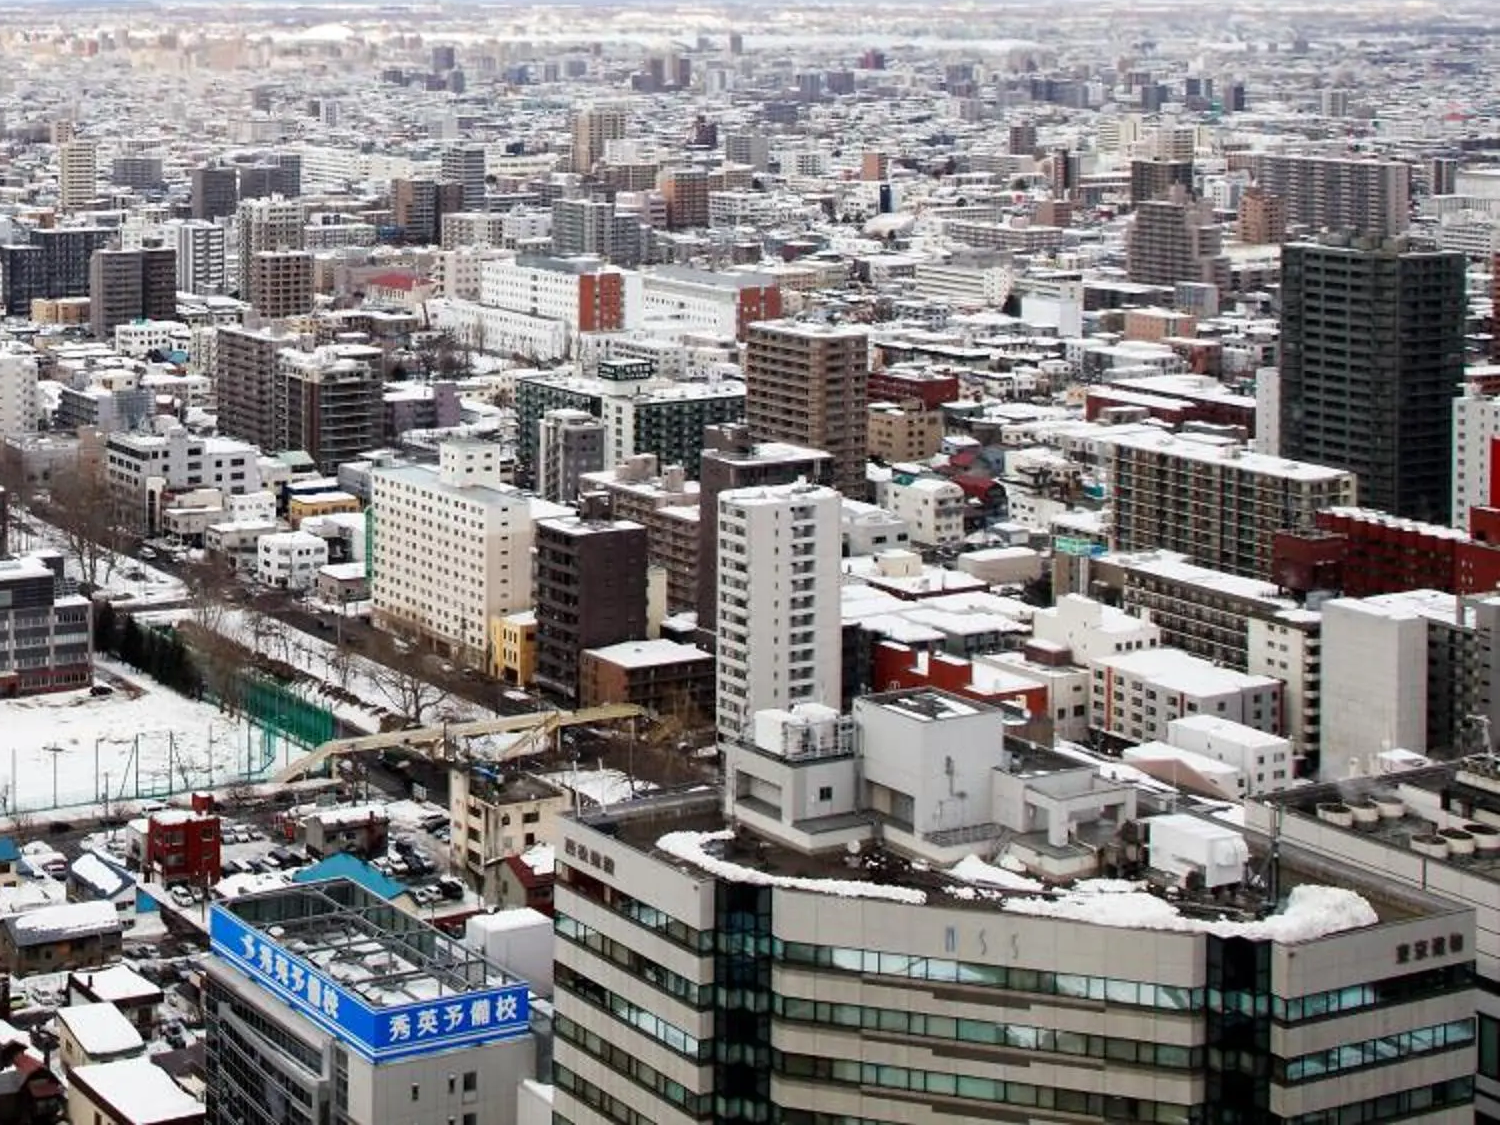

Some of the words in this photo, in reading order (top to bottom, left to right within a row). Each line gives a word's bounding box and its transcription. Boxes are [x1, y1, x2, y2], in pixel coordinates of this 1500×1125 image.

[389, 994, 517, 1042] 秀英予備校
